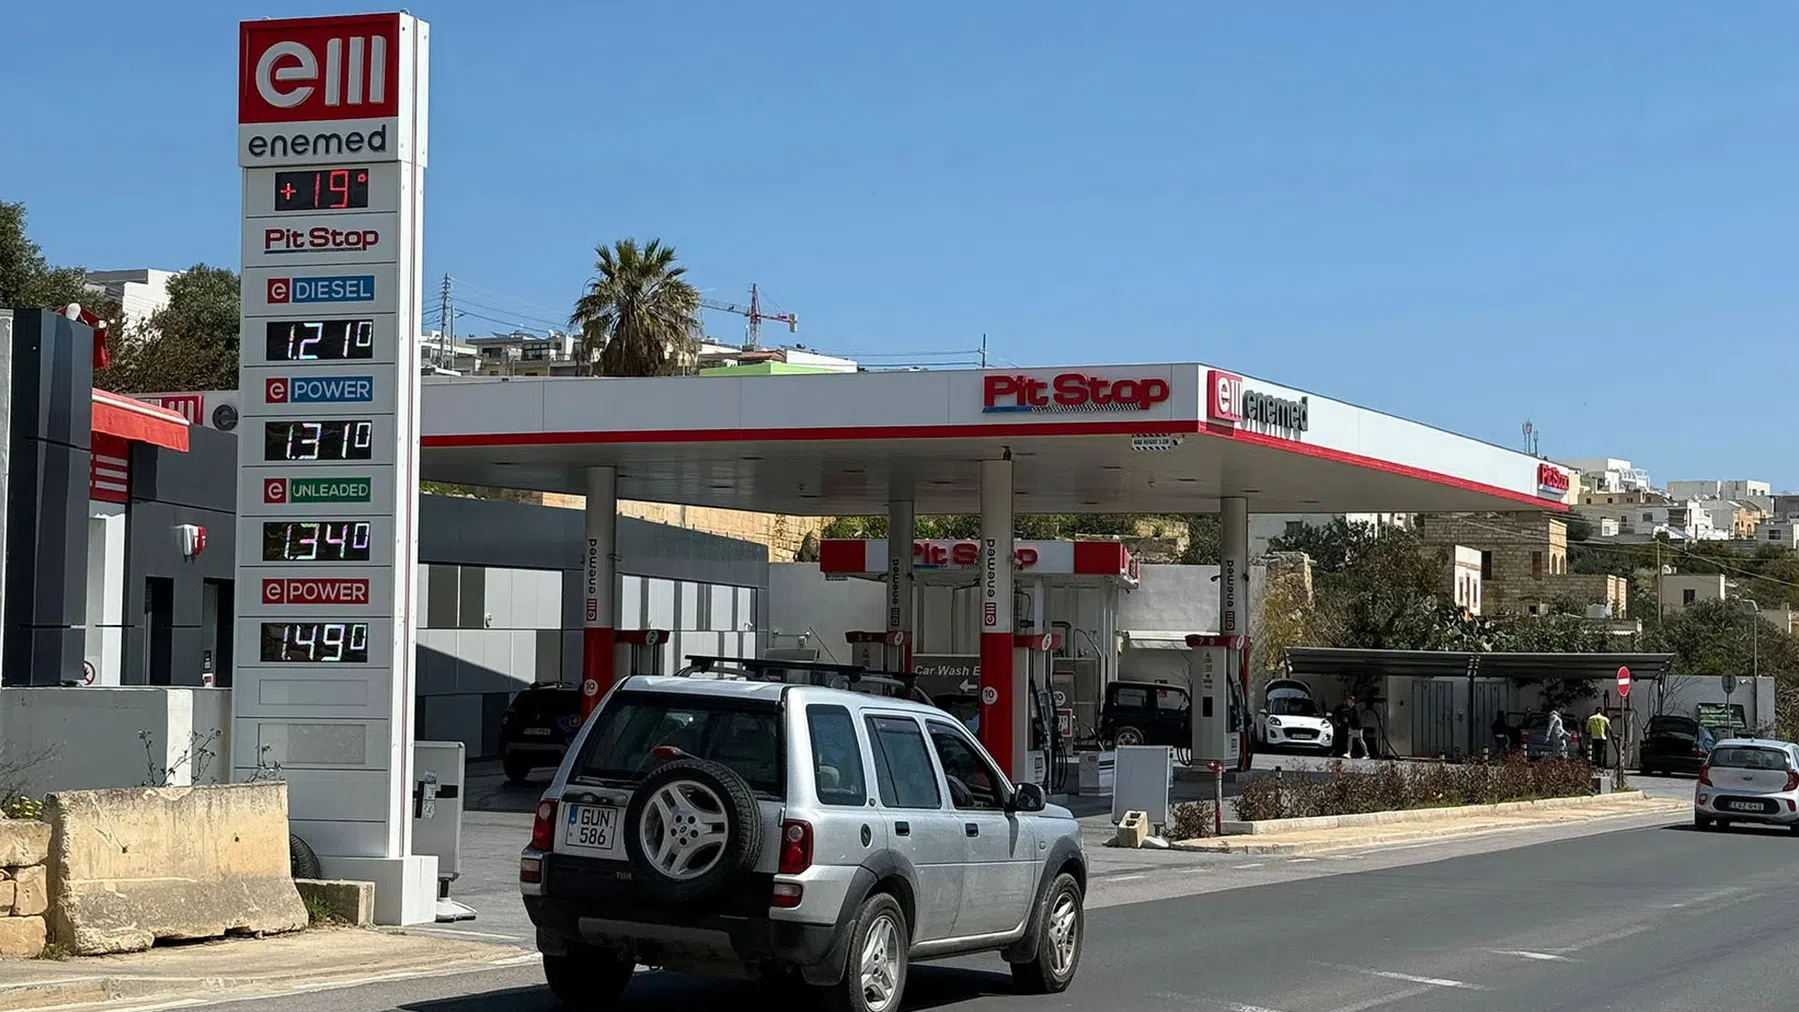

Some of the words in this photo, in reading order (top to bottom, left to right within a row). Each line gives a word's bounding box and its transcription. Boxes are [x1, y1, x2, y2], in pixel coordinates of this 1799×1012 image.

[248, 124, 387, 158] enemed
[265, 228, 306, 250] Pit
[308, 227, 380, 251] Stop
[295, 280, 371, 299] DIESEL
[294, 380, 370, 399] POWER
[984, 374, 1050, 407] Pit
[1052, 373, 1170, 410] Stop
[1242, 389, 1309, 432] enemed
[292, 483, 369, 497] UNLEADED
[588, 538, 598, 595] enemed
[987, 538, 997, 598] enemed
[290, 583, 366, 601] POWER
[892, 558, 900, 605] enemed
[1226, 559, 1235, 608] enemed
[914, 665, 935, 676] Car
[937, 665, 969, 677] Wash
[983, 689, 995, 699] 10
[580, 808, 610, 828] GUN
[579, 827, 607, 845] 586
